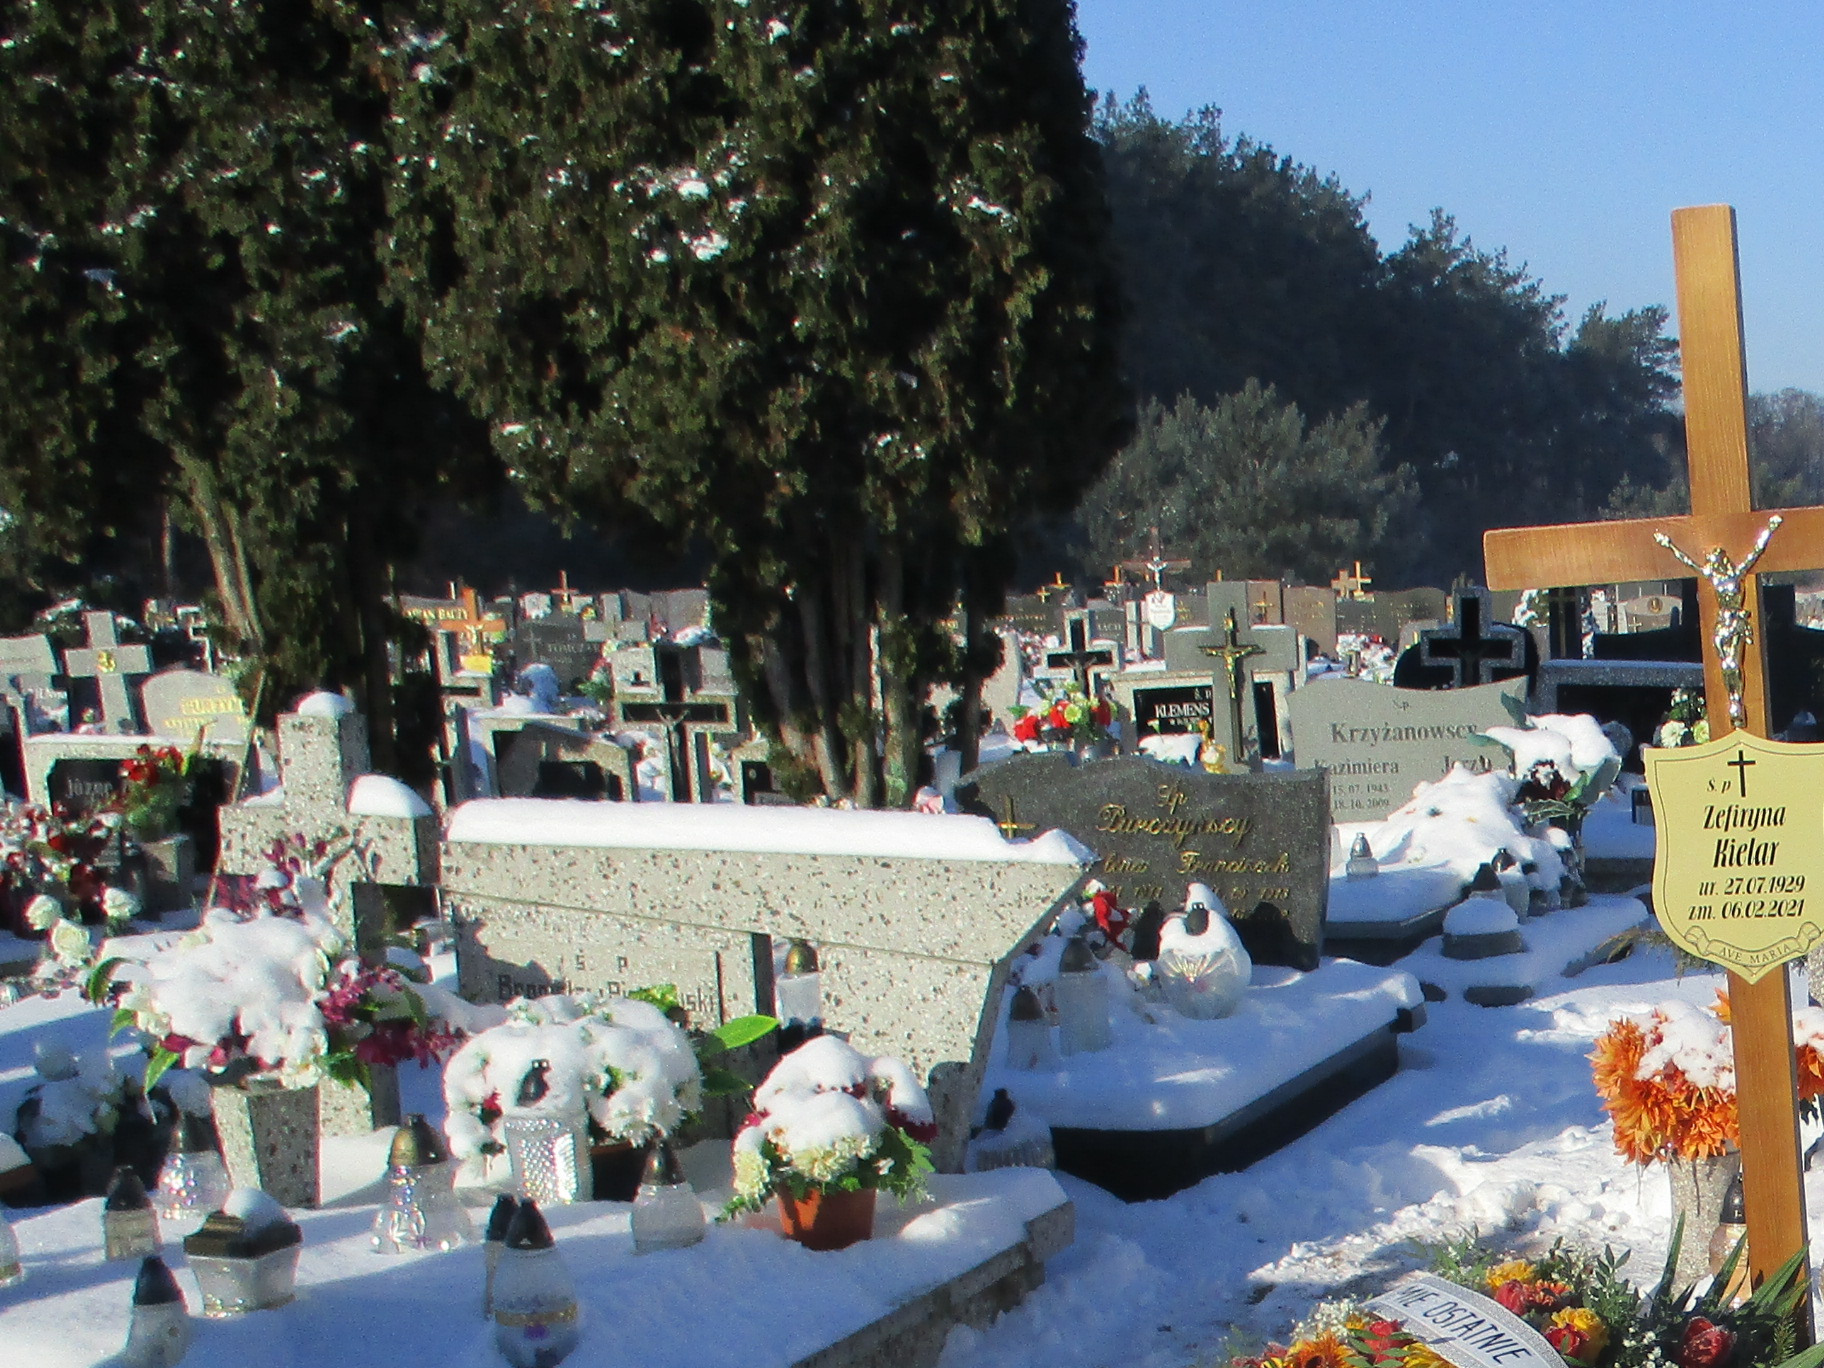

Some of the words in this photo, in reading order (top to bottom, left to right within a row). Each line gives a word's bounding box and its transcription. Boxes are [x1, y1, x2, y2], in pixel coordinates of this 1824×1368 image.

[1154, 702, 1210, 718] KLEMENS
[1703, 804, 1786, 832] Zefiryna
[1713, 838, 1780, 868] Kielar
[1699, 881, 1719, 896] ur.
[1724, 875, 1806, 895] 27.07.1929
[1688, 904, 1716, 920] zm.
[1721, 899, 1804, 919] 06.02.2021
[1719, 946, 1743, 962] AVE
[1749, 944, 1791, 965] MARIA
[1423, 1300, 1533, 1366] OSTATNIE
